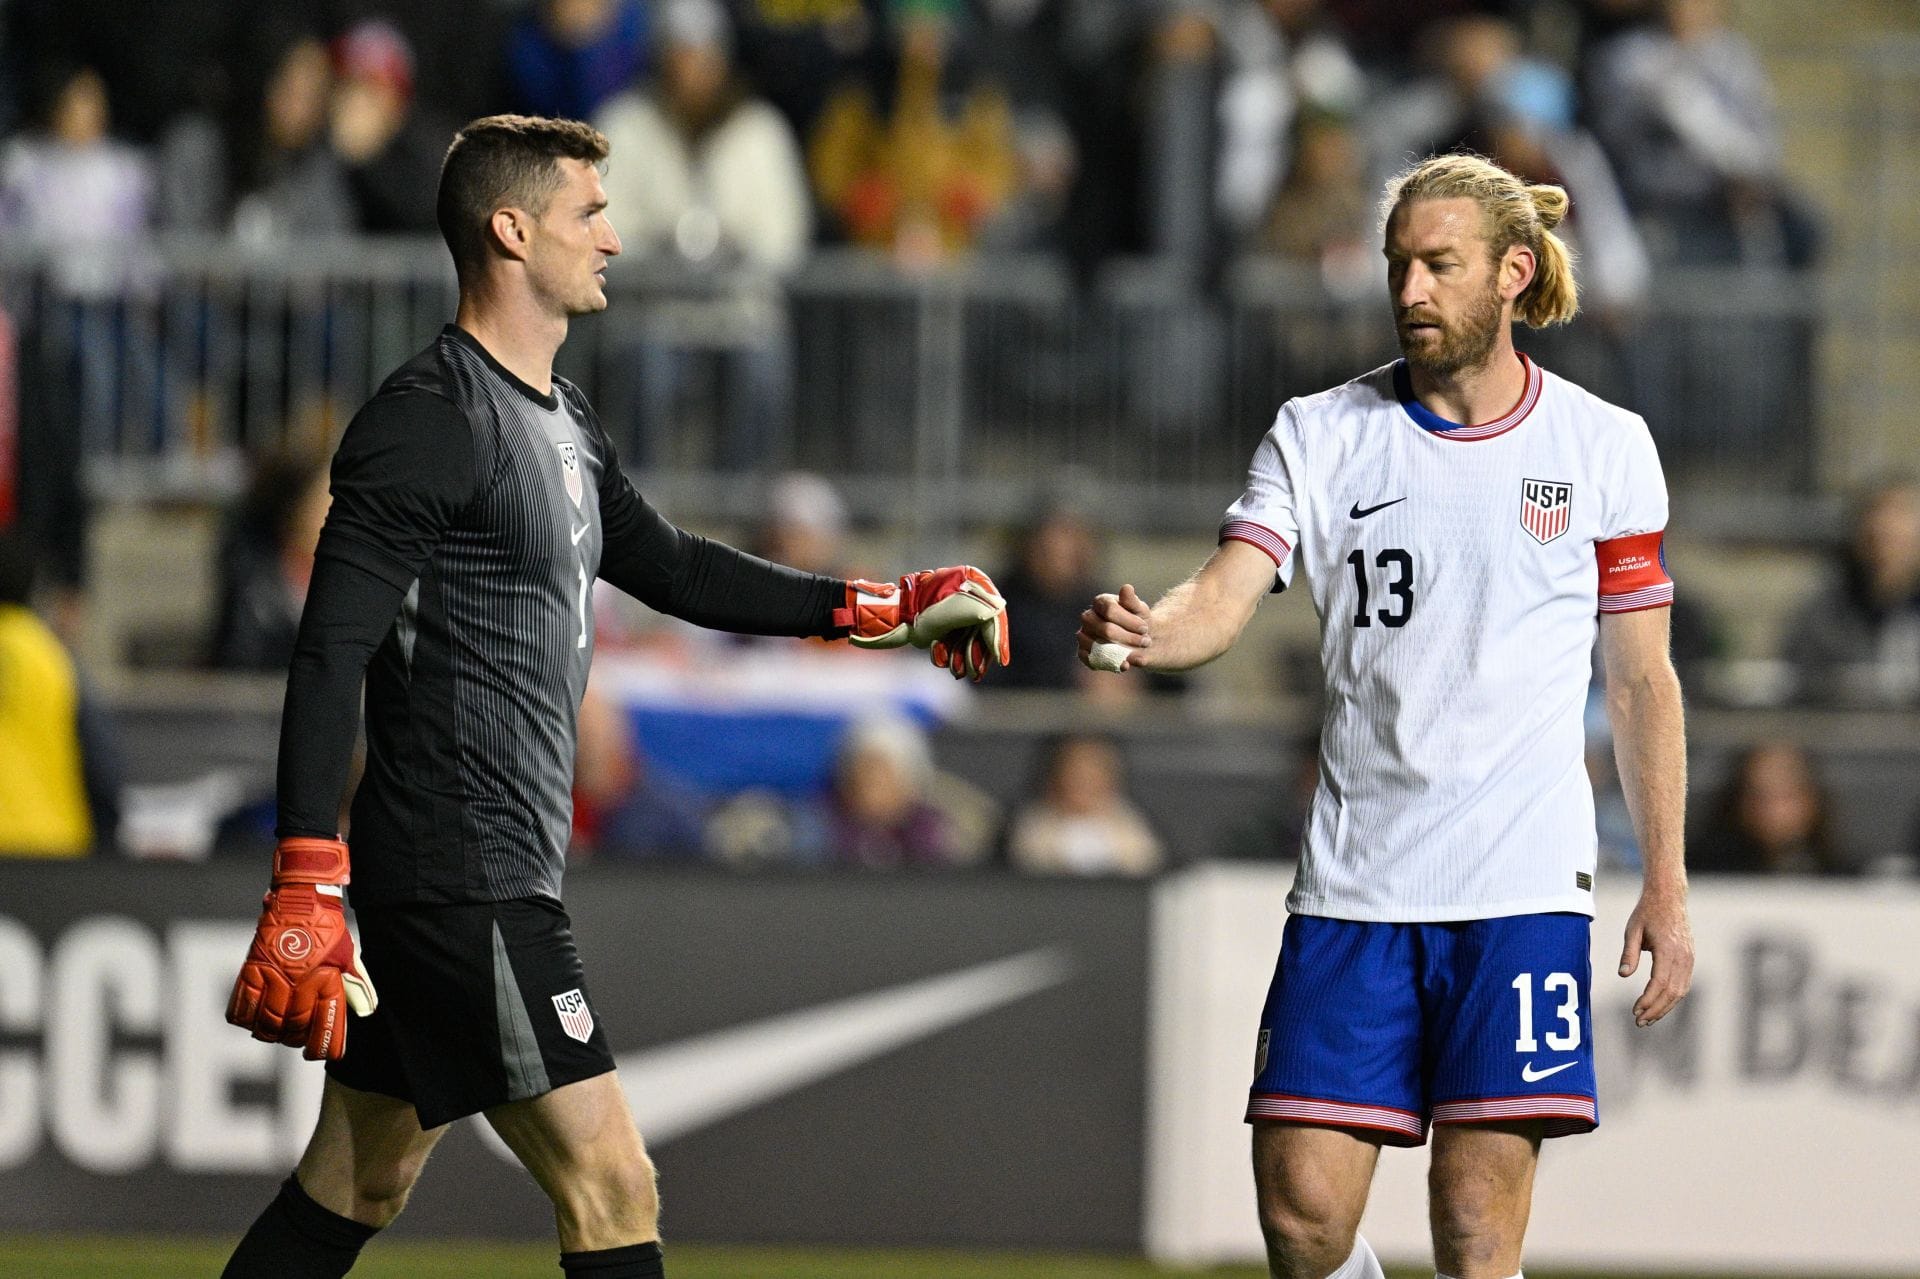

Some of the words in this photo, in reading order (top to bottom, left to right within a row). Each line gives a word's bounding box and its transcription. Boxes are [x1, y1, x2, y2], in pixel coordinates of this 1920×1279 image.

[1526, 483, 1568, 508] USA
[1608, 560, 1651, 574] PARAGUAY
[1618, 556, 1637, 565] USA
[1347, 548, 1414, 628] 13
[578, 562, 588, 648] 1
[326, 999, 337, 1030] WEST
[556, 993, 583, 1013] USA
[1512, 972, 1581, 1052] 13
